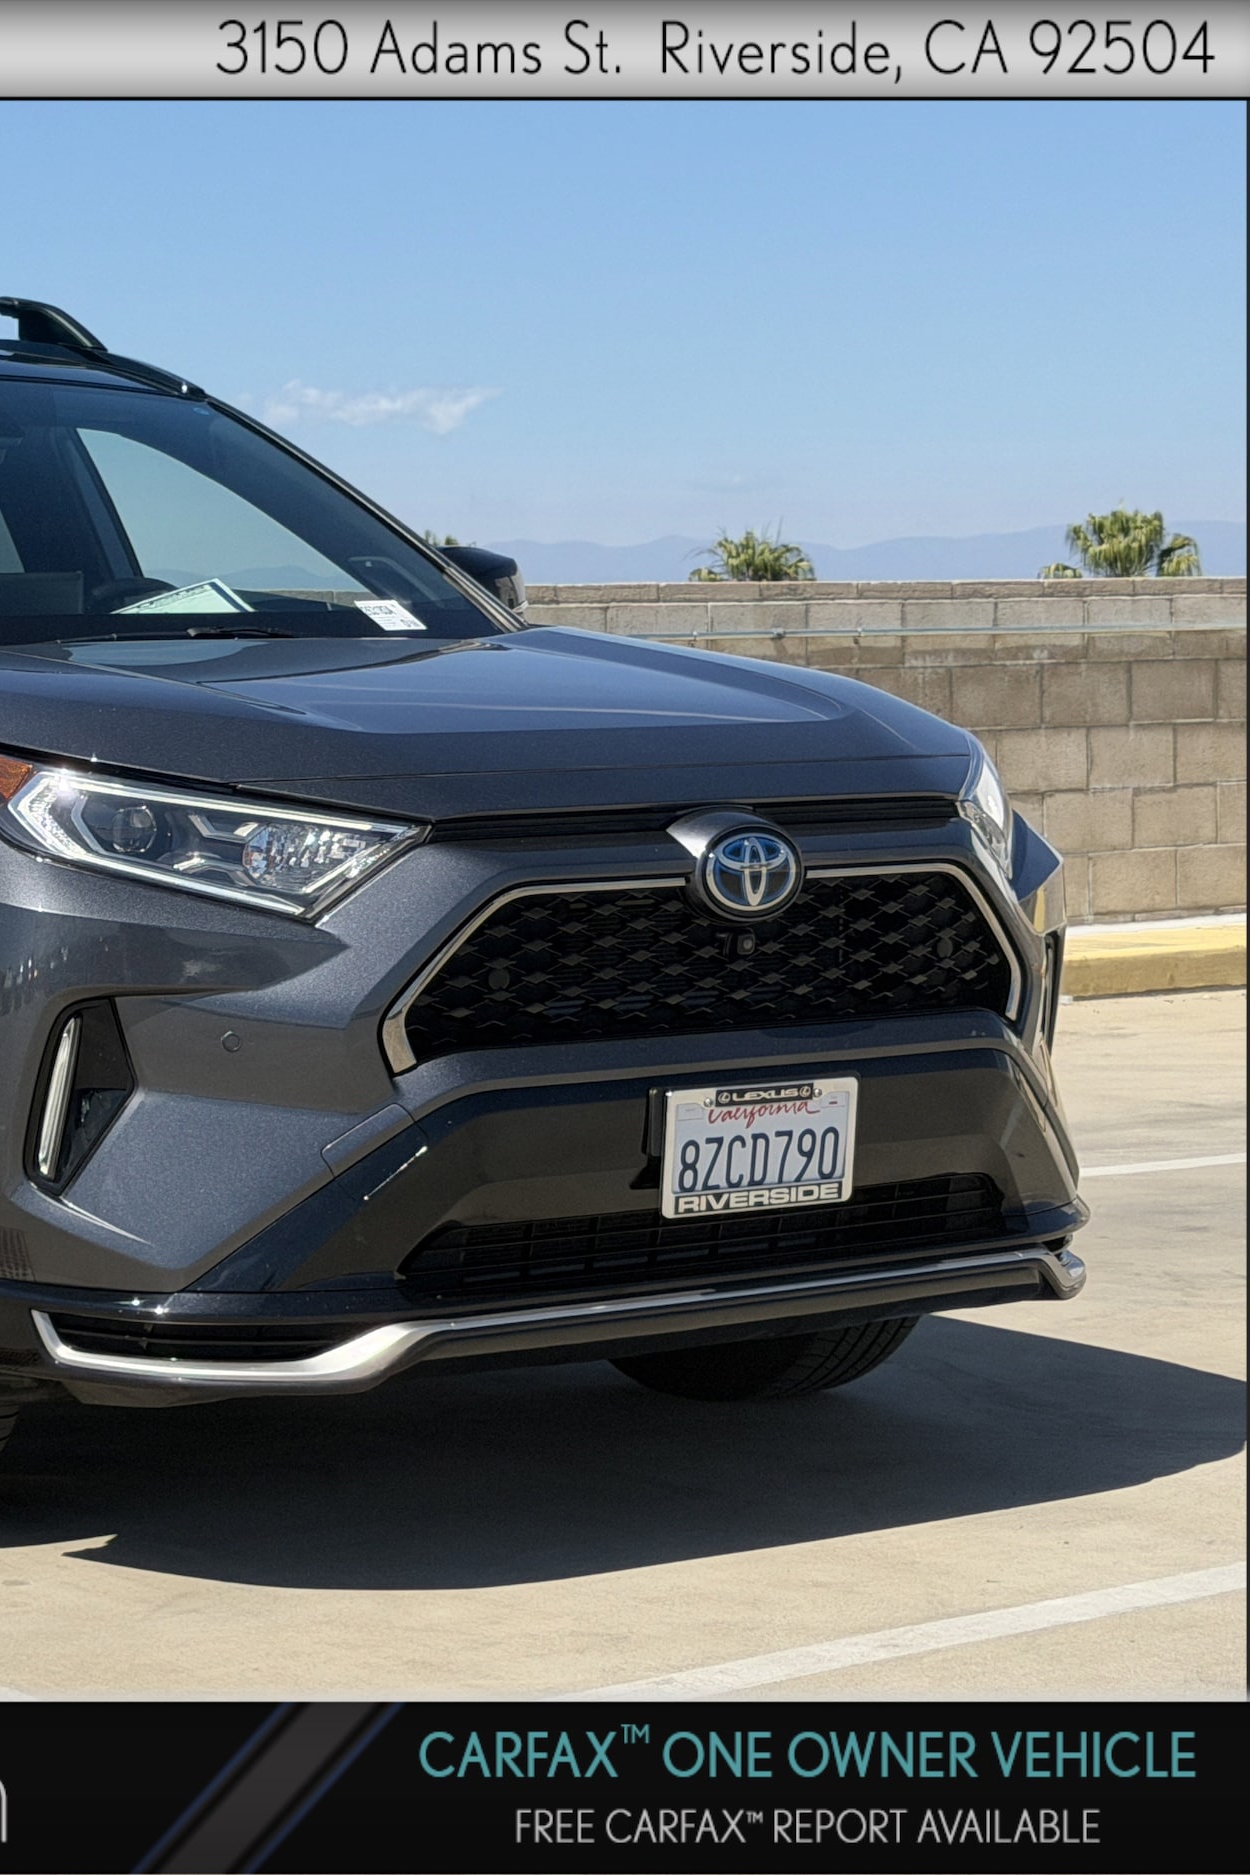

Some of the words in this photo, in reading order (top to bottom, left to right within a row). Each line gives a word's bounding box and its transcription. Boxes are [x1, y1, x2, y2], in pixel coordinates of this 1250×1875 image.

[731, 1087, 799, 1102] LEXUS
[677, 1126, 840, 1193] 8ZCD790
[677, 1183, 840, 1214] RIVERSIDE
